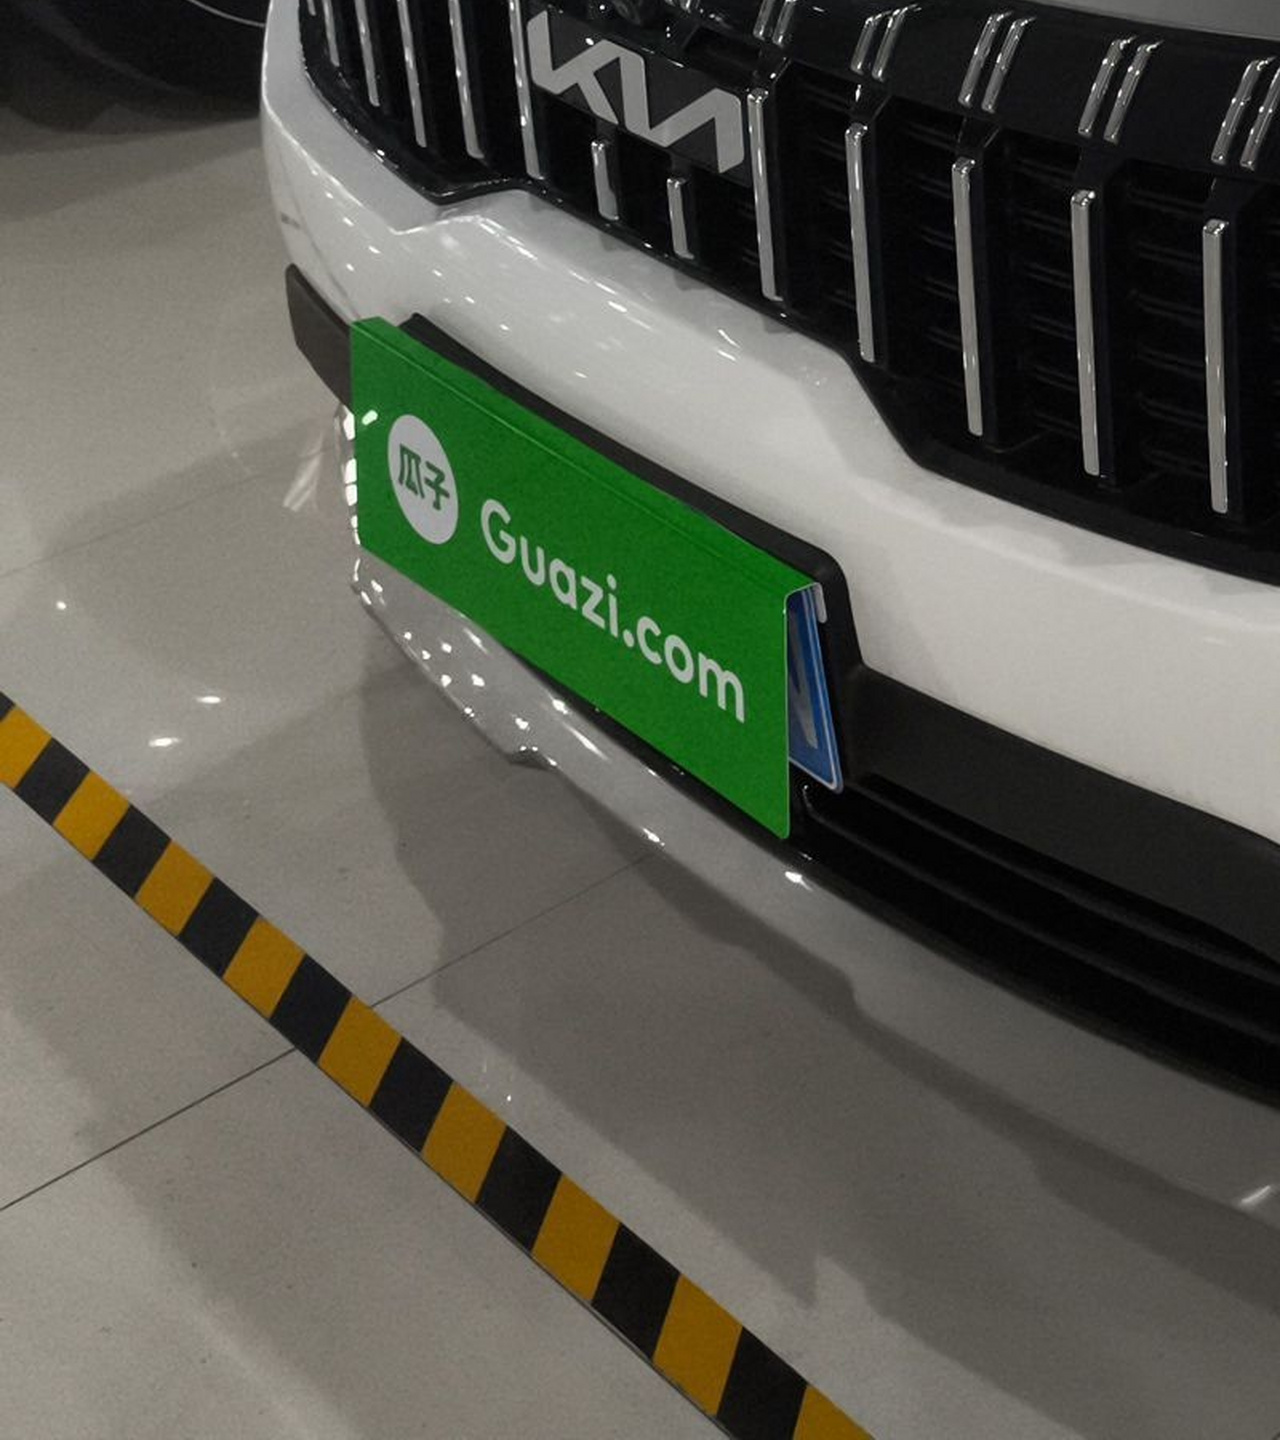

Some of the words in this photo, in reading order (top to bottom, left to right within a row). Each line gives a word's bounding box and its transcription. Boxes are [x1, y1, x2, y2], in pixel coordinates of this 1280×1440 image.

[526, 10, 744, 174] KIA
[398, 443, 450, 511] 瓜子
[480, 498, 745, 723] Guazi.com
